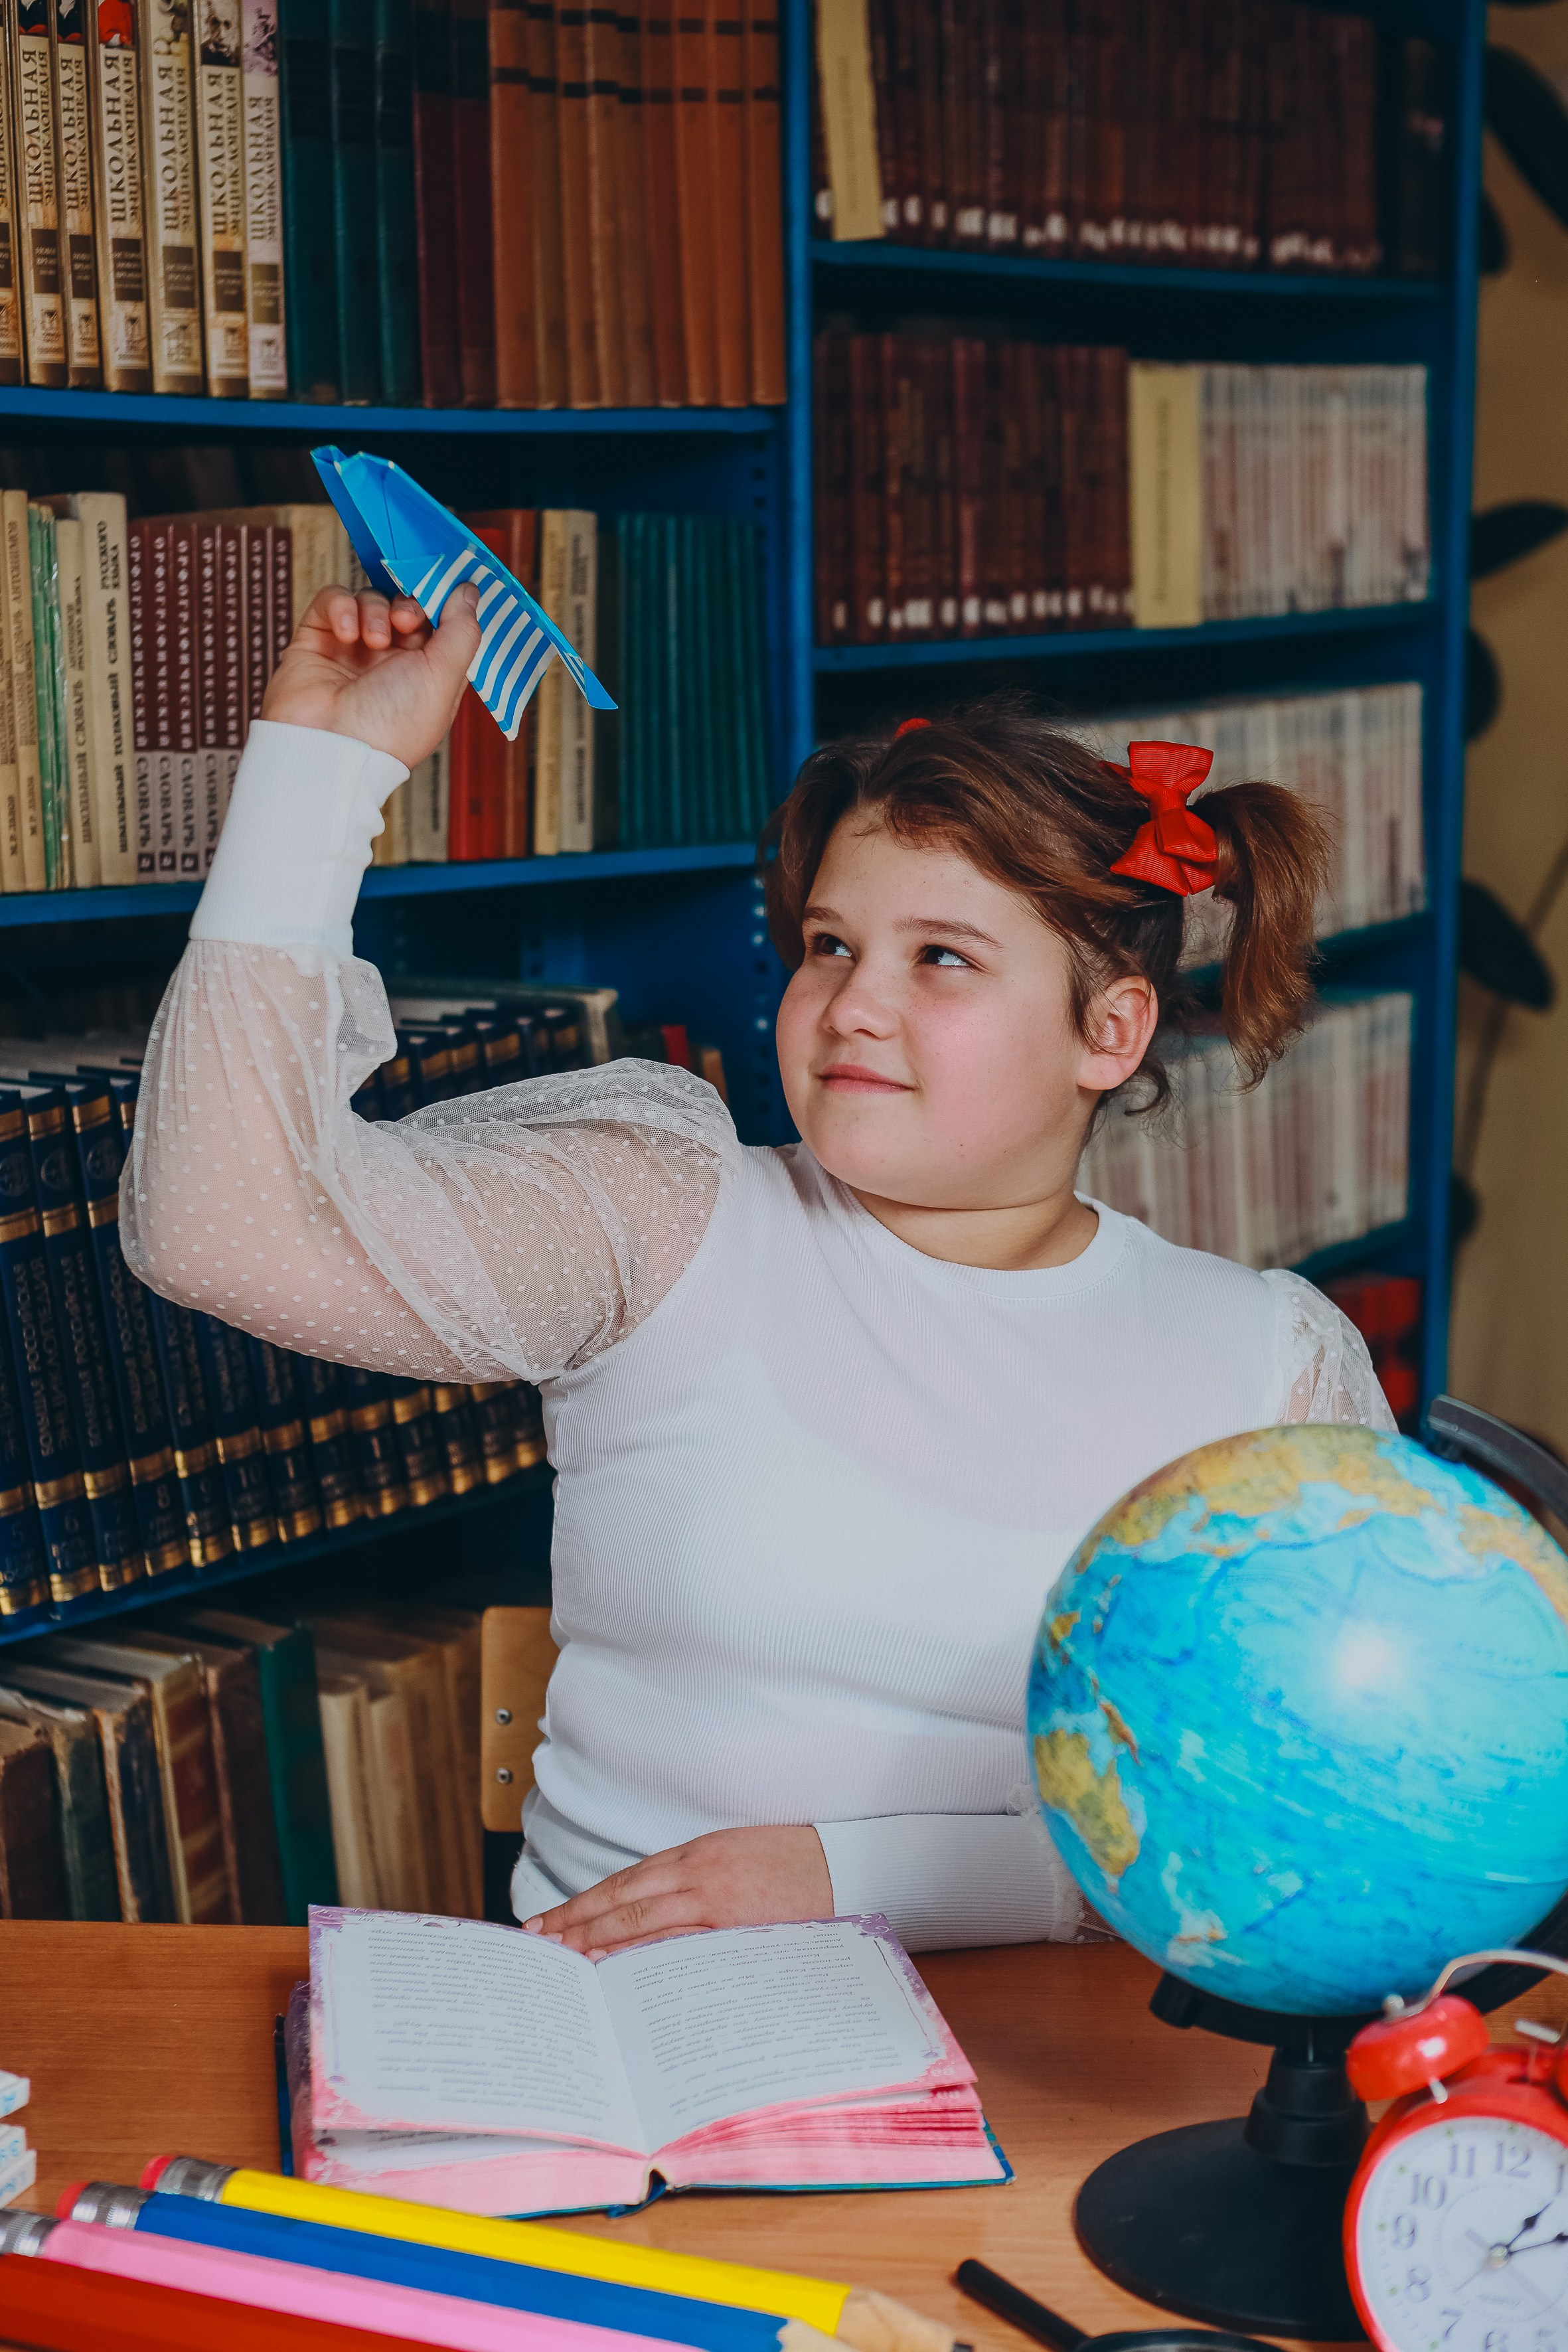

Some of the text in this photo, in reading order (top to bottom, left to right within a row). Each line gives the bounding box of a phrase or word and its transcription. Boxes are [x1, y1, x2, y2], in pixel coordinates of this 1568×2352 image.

[23, 50, 43, 204] ШКОЛЬНАЯ
[38, 51, 54, 206] ЭНЦИКЛОПЕДИЯ
[60, 58, 79, 210] ШКОЛЬНАЯ
[104, 56, 125, 222] ШКОЛЬНАЯ
[123, 57, 138, 223] ЭНЦИКЛОПЕДИЯ
[159, 66, 179, 230] ШКОЛЬНАЯ
[207, 74, 226, 234] ШКОЛЬНАЯ
[249, 97, 268, 240] ШКОЛЬНАЯ
[109, 544, 121, 589] ЯЗЫКА
[200, 537, 216, 746] ОРФОГРАФИЧЕСКИЙ
[224, 539, 240, 745] ОРФОГРАФИЧЕСКИЙ
[97, 521, 128, 854] ШКОЛЬНЫЙ ТОЛКОВЫЙ СЛОВАРЬ РУССКОГО
[128, 536, 153, 847] ОРФОГРАФИЧЕСКИЙ СЛОВАРЬ
[153, 536, 174, 847] ОРФОГРАФИЧЕСКИЙ СЛОВАРЬ
[177, 540, 195, 847] ОРФОГРАФИЧЕСКИЙ СЛОВАРЬ
[73, 680, 86, 745] СЛОВАРЬ
[75, 753, 92, 843] ШКОЛЬНЫЙ
[60, 1256, 88, 1365] РОССИЙСКАЯ
[31, 1256, 74, 1449] ЭНЦИКЛОПЕДИЯ
[107, 1245, 148, 1434] БОЛЬШАЯ РОССИЙСКАЯ
[13, 1264, 55, 1457] БОЛЬШАЯ РОССИЙСКАЯ
[78, 1370, 102, 1448] БОЛЬШАЯ
[199, 1478, 212, 1503] 9
[238, 1462, 262, 1490] 10
[157, 1483, 171, 1509] 8
[64, 1509, 79, 1533] 6
[518, 1962, 548, 1973] Никто
[650, 1954, 706, 1970] собственно,
[708, 1948, 738, 1957] Какая,
[629, 1967, 648, 1976] раз-
[632, 1970, 664, 1983] прики-
[633, 1978, 664, 1991] Лиззи,
[668, 1968, 709, 1980] ответила
[686, 1980, 716, 1990] прямо
[763, 1981, 810, 1990] сторонам.
[641, 1996, 683, 2012] шепотом
[686, 1998, 738, 2013] принялись
[705, 1986, 726, 1995] нас?
[717, 1999, 782, 2013] остановилась
[743, 1990, 798, 2000] озадаченно
[684, 2012, 713, 2022] перед
[684, 2015, 730, 2029] говорите,
[753, 2012, 789, 2021] потому
[784, 2015, 830, 2025] добавила,
[793, 2007, 837, 2016] Избенку,
[647, 2021, 681, 2036] Избен-
[650, 2029, 682, 2043] ладно?
[651, 2035, 686, 2050] внутри
[689, 2024, 728, 2037] прячусь
[1449, 2143, 1476, 2177] 11
[1494, 2141, 1533, 2178] 12
[1410, 2172, 1447, 2209] 10
[1391, 2213, 1417, 2250] 9
[1403, 2266, 1431, 2302] 8
[1441, 2308, 1464, 2341] 7
